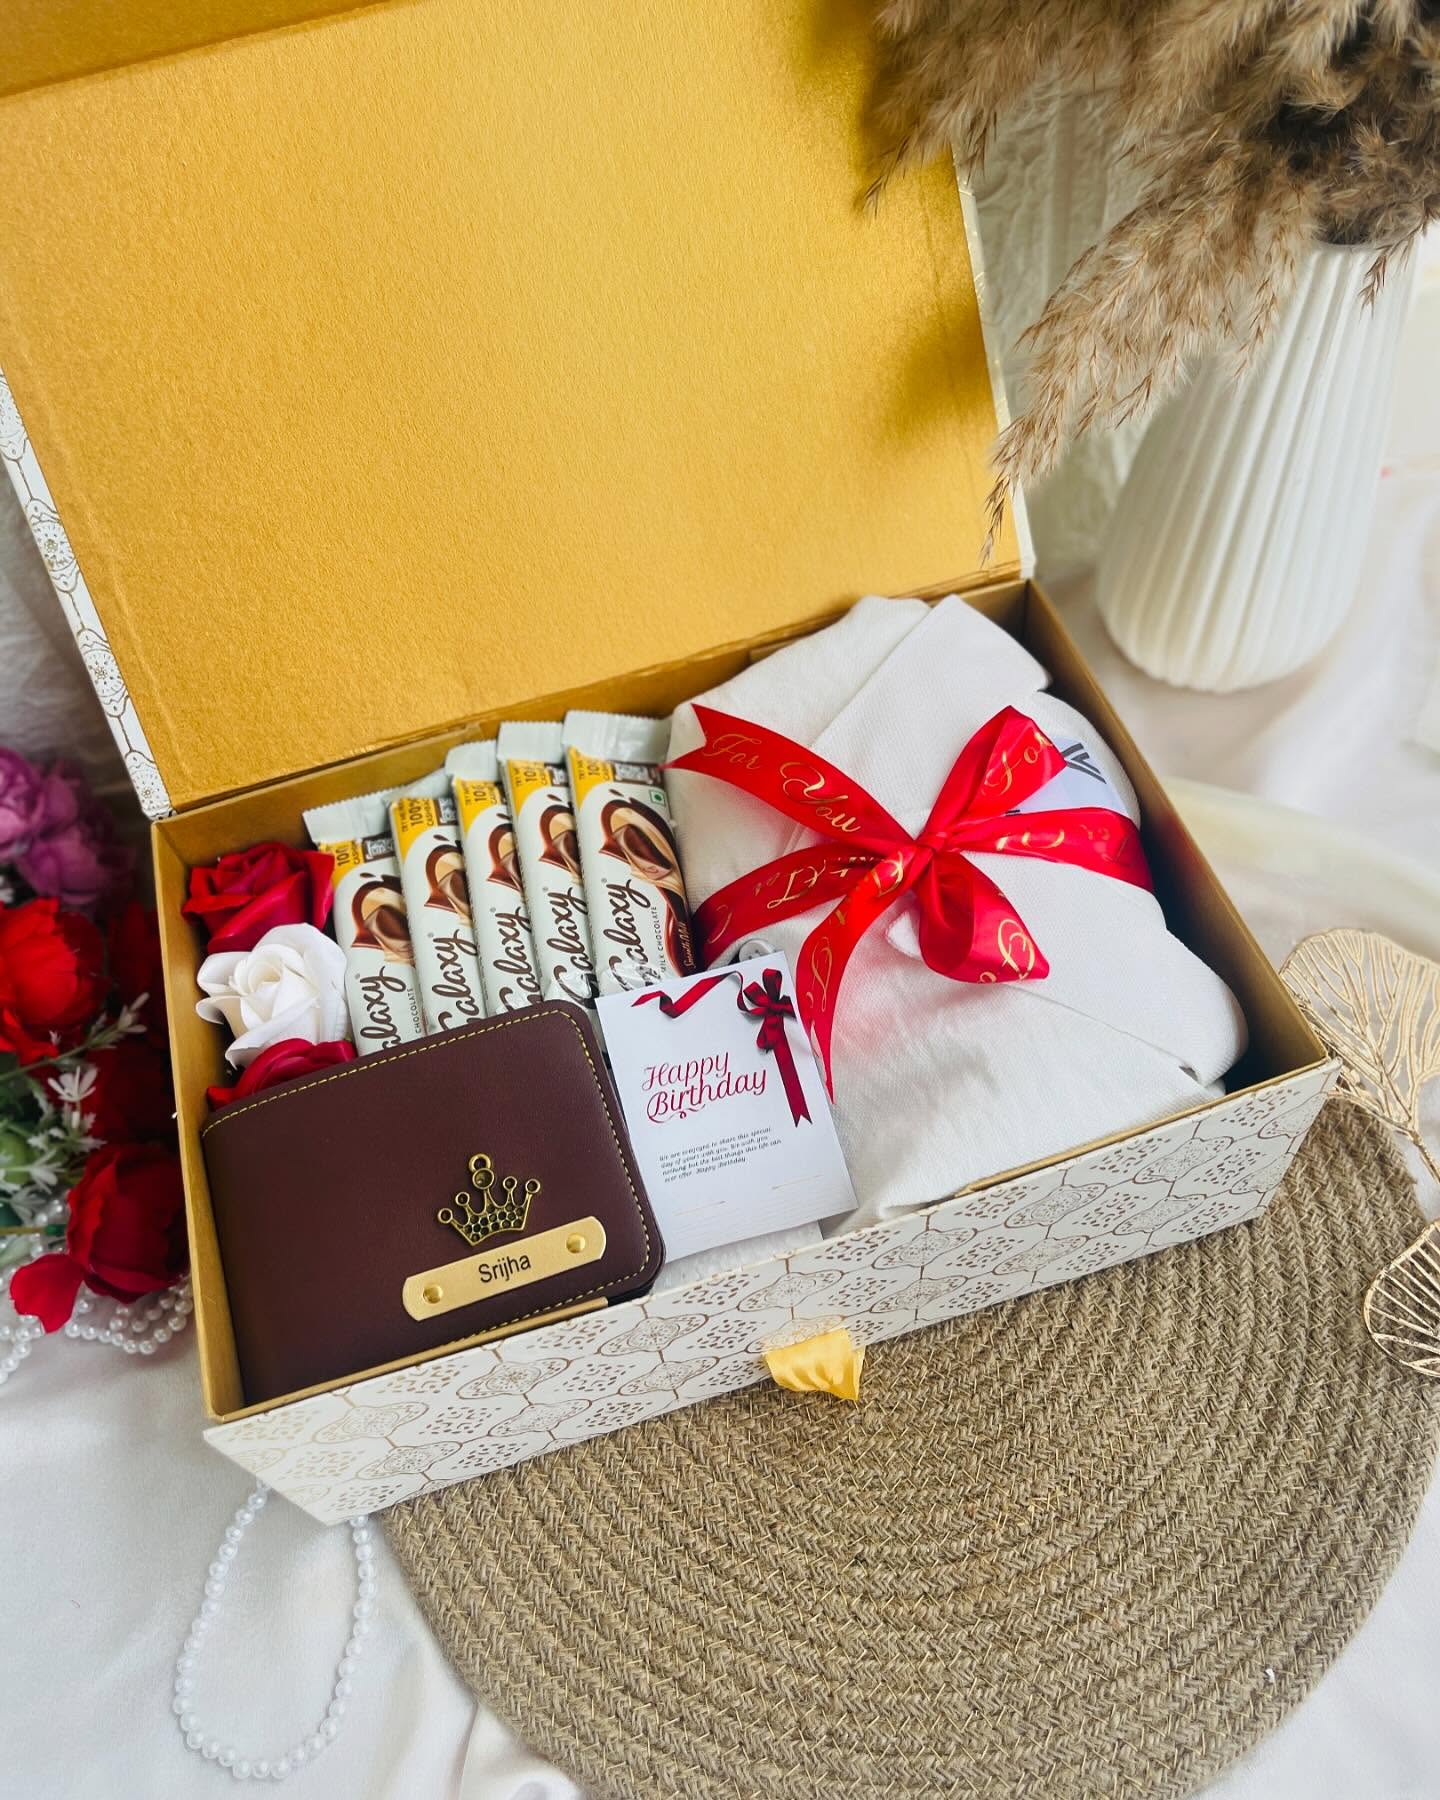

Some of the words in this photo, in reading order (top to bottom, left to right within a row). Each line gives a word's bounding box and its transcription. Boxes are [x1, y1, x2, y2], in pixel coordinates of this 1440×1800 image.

[703, 733, 762, 770] For
[779, 761, 861, 832] You
[651, 906, 664, 951] CHOCOLATE
[641, 1051, 729, 1092] Happy
[647, 1069, 767, 1123] Birthday
[478, 1254, 531, 1284] Srijha
